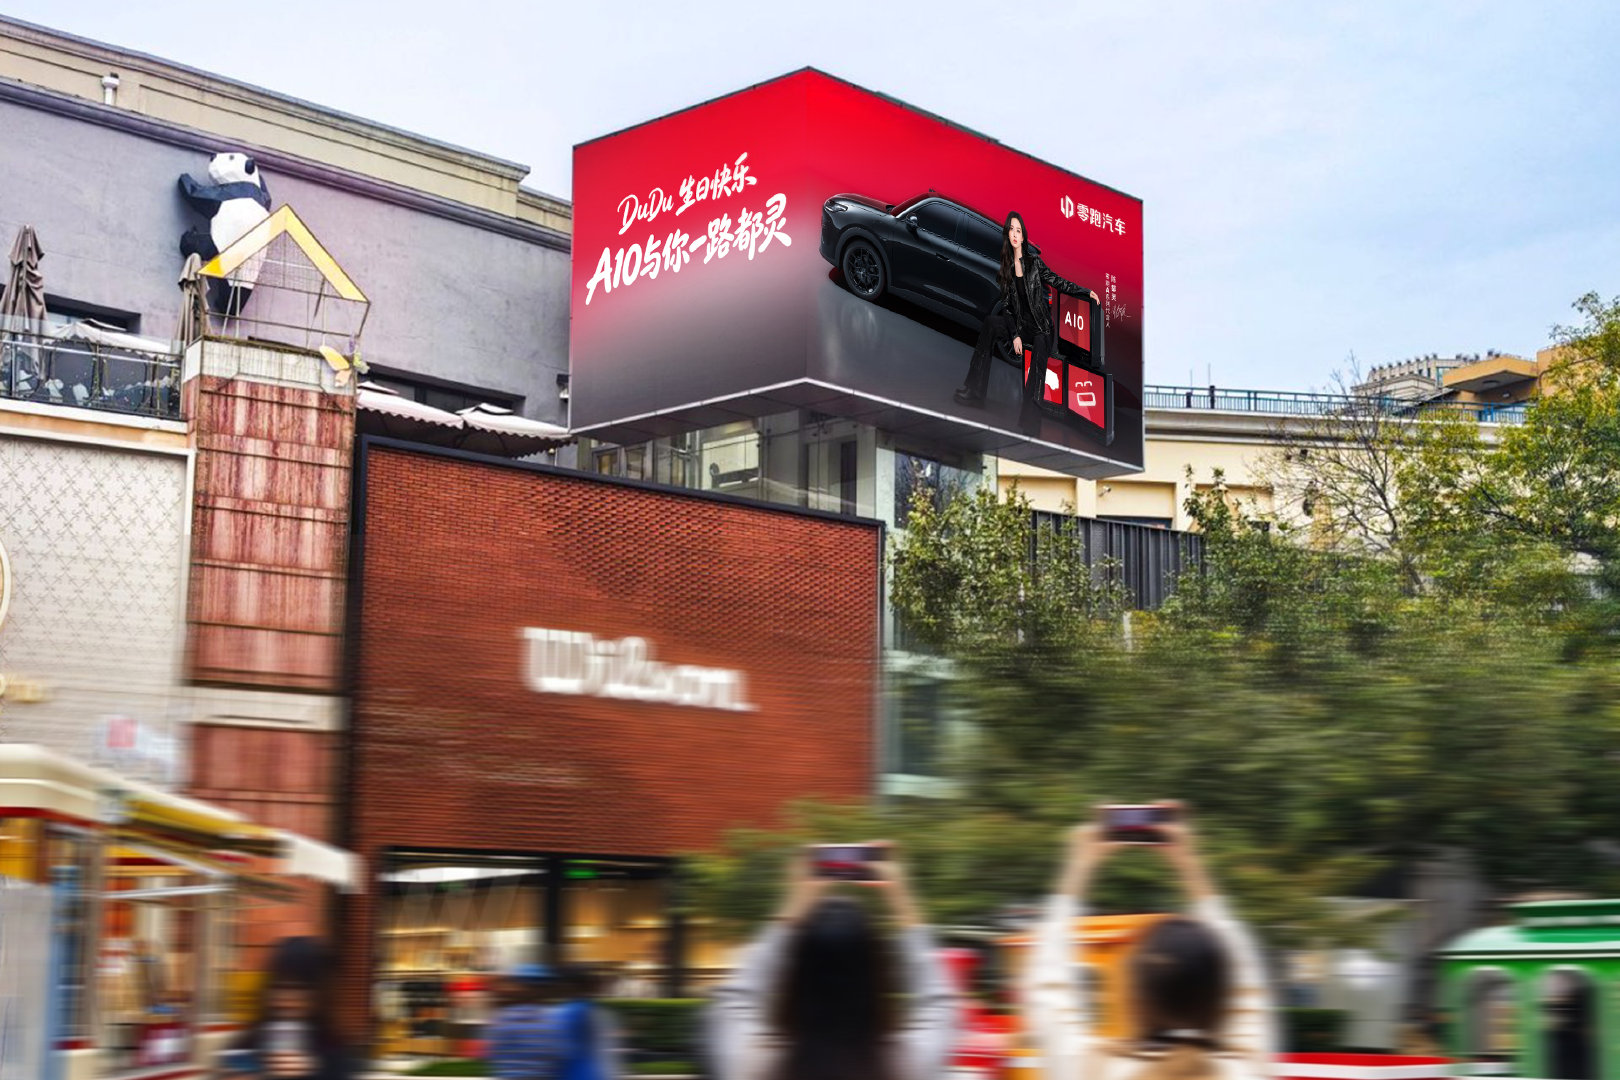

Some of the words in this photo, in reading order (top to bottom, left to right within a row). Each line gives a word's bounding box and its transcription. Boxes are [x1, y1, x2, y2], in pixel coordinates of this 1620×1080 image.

[616, 187, 674, 235] DuDu
[675, 152, 757, 216] 生日快乐
[1077, 203, 1126, 236] 零跑汽车
[585, 193, 792, 305] A10与你一路都灵
